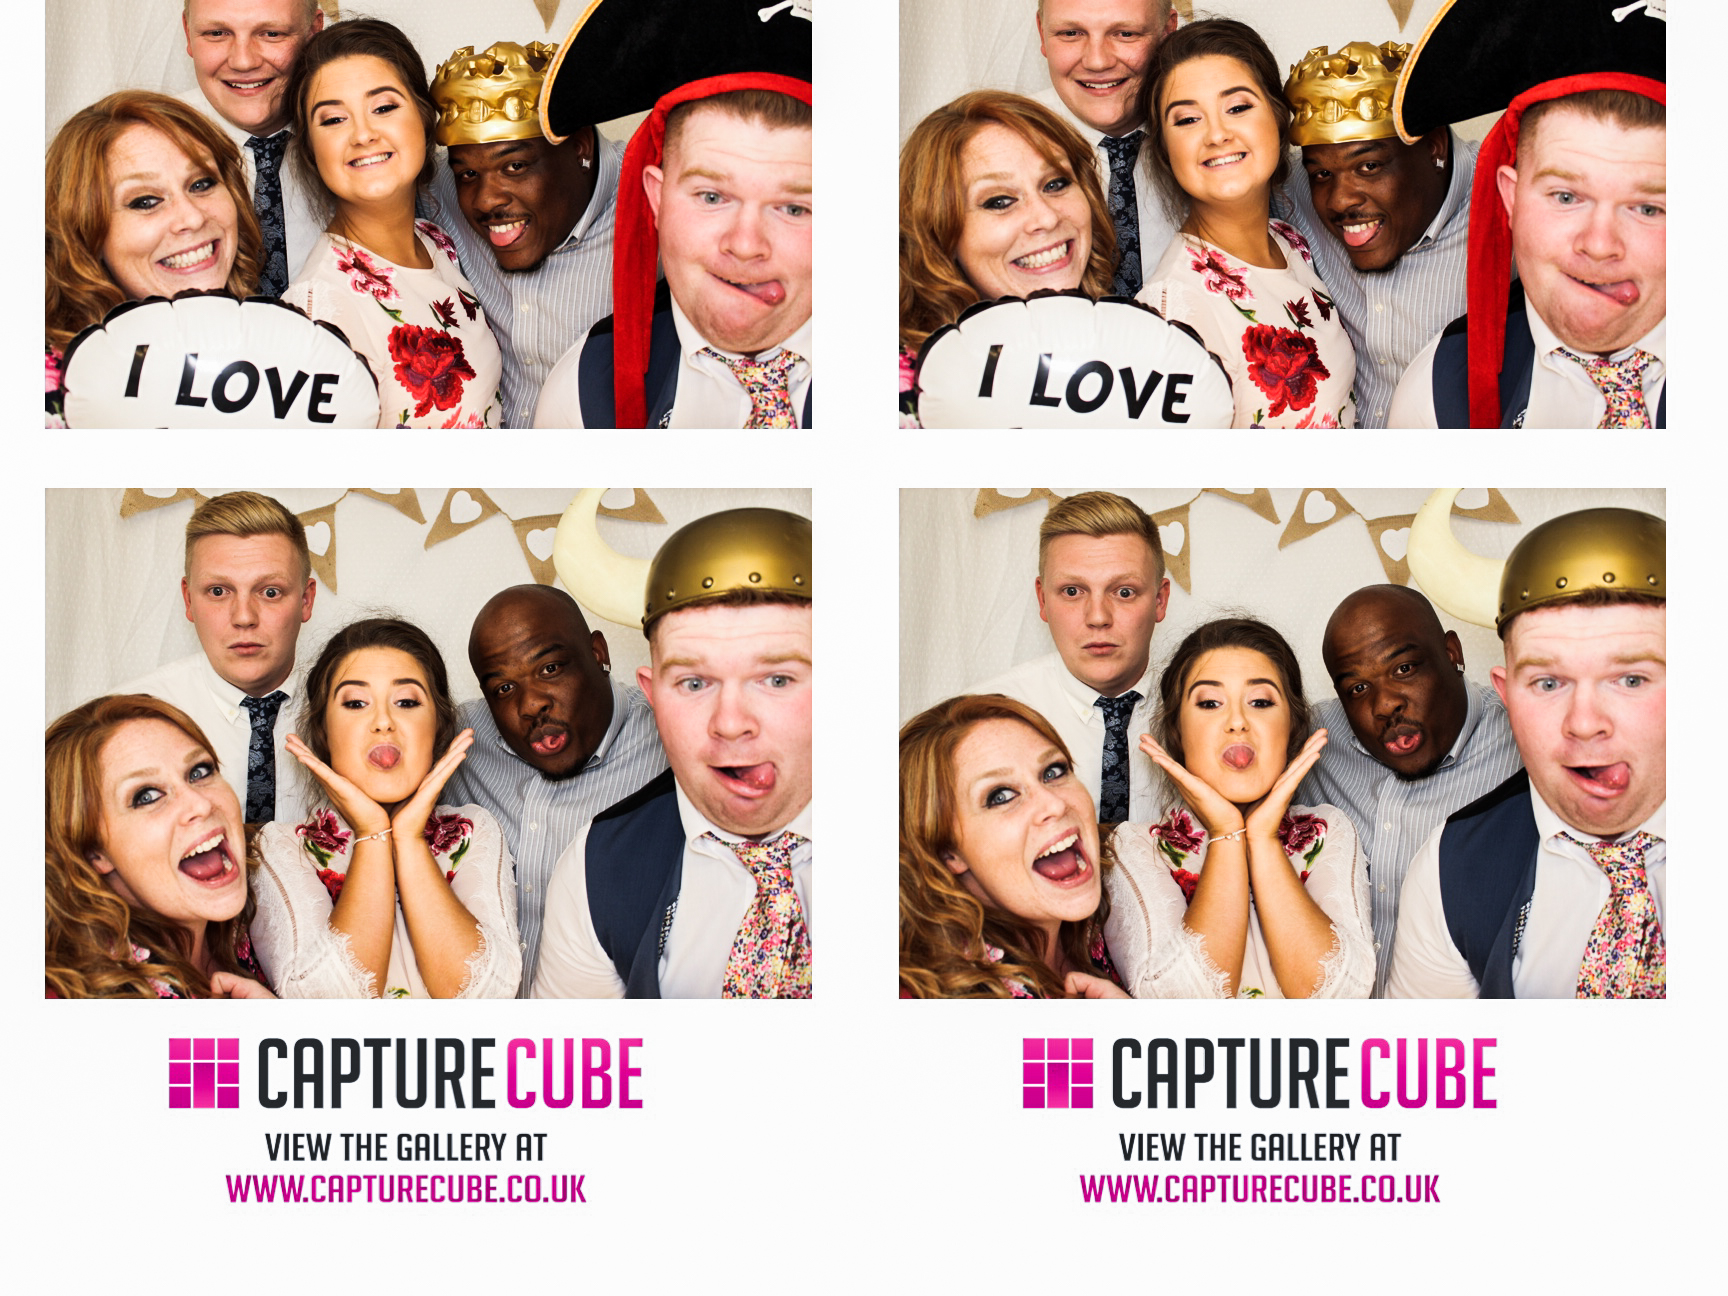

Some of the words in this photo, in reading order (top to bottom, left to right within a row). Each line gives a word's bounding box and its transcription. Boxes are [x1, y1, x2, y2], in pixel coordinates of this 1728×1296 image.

[124, 344, 150, 398] I
[175, 353, 340, 424] LOVE
[978, 344, 1004, 398] I
[1029, 353, 1194, 424] LOVE
